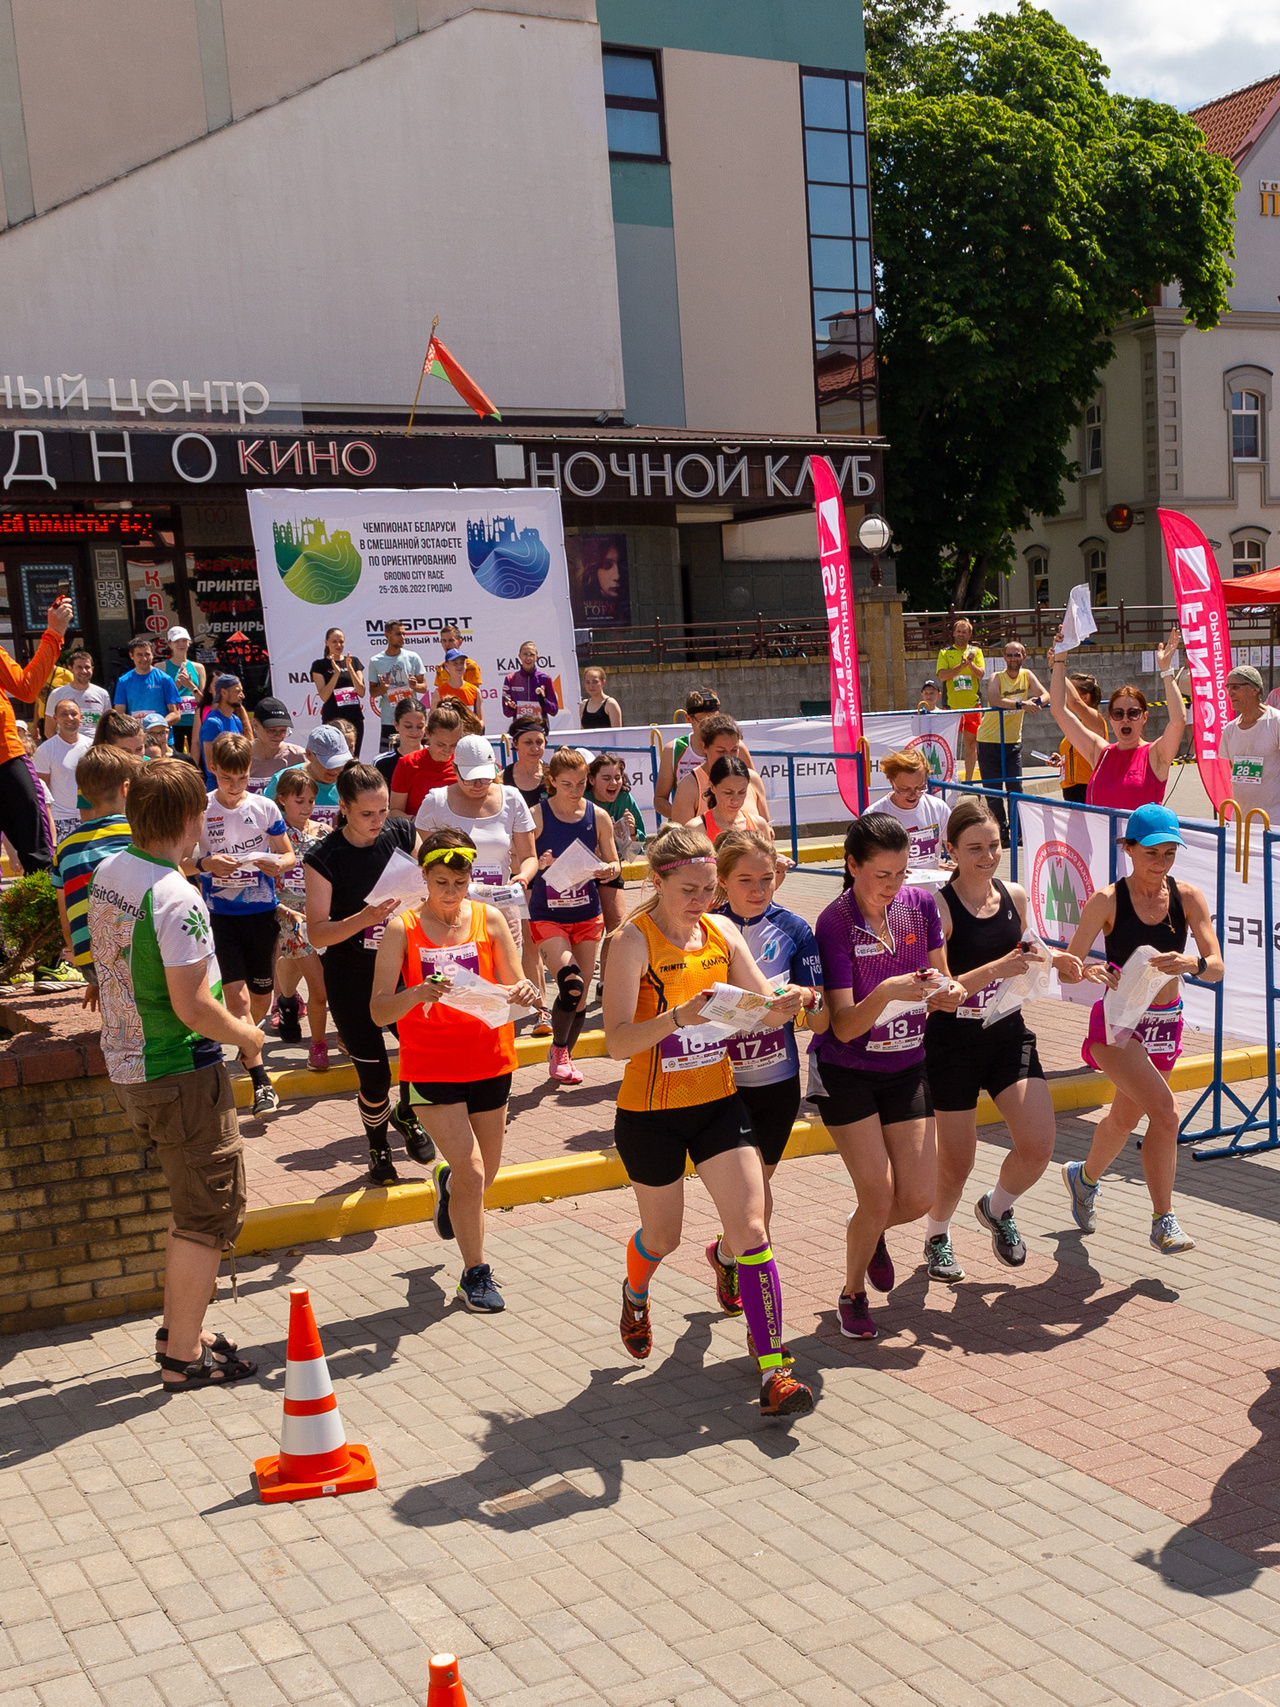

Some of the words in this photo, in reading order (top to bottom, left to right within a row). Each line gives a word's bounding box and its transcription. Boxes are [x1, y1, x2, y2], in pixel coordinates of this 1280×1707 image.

[108, 377, 270, 424] центр
[237, 439, 377, 477] КИНО
[529, 444, 750, 498] НОЧНОЙ
[363, 521, 413, 533] ЧЕМПИОНАТ
[415, 521, 457, 533] БЕЛАРУСИ
[360, 540, 366, 550] В
[367, 536, 420, 550] СМЕШАННОЙ
[421, 537, 462, 549] ЭСТАФЕТЕ
[369, 555, 380, 566] ПО
[382, 554, 457, 566] ОРИЕНТИРОВАНИЮ
[384, 571, 411, 580] GRODNO
[412, 571, 426, 580] CITY
[428, 570, 445, 580] RACE
[379, 585, 427, 594] 25-26.06.2022
[427, 583, 453, 593] ГРОДНО
[199, 600, 257, 613] СКАНЕР
[659, 962, 688, 974] TRIMTEX
[886, 1019, 921, 1039] 13-1
[1144, 1026, 1171, 1041] 11-1
[736, 1039, 779, 1060] 17-1
